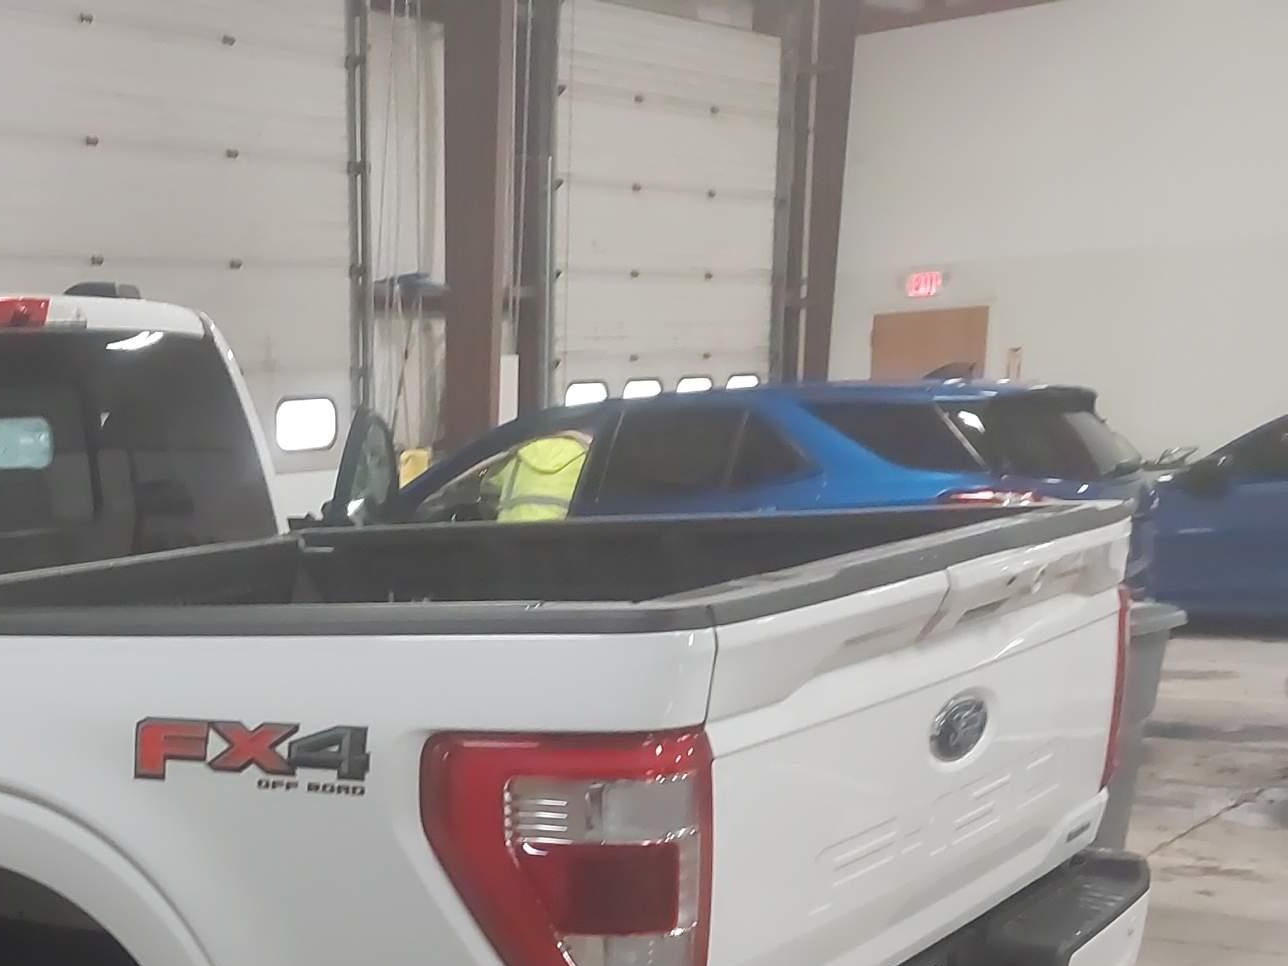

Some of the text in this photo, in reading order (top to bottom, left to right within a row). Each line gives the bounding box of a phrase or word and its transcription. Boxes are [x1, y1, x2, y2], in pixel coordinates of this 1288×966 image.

[134, 717, 370, 781] FX4
[256, 778, 366, 797] OFF ROAD
